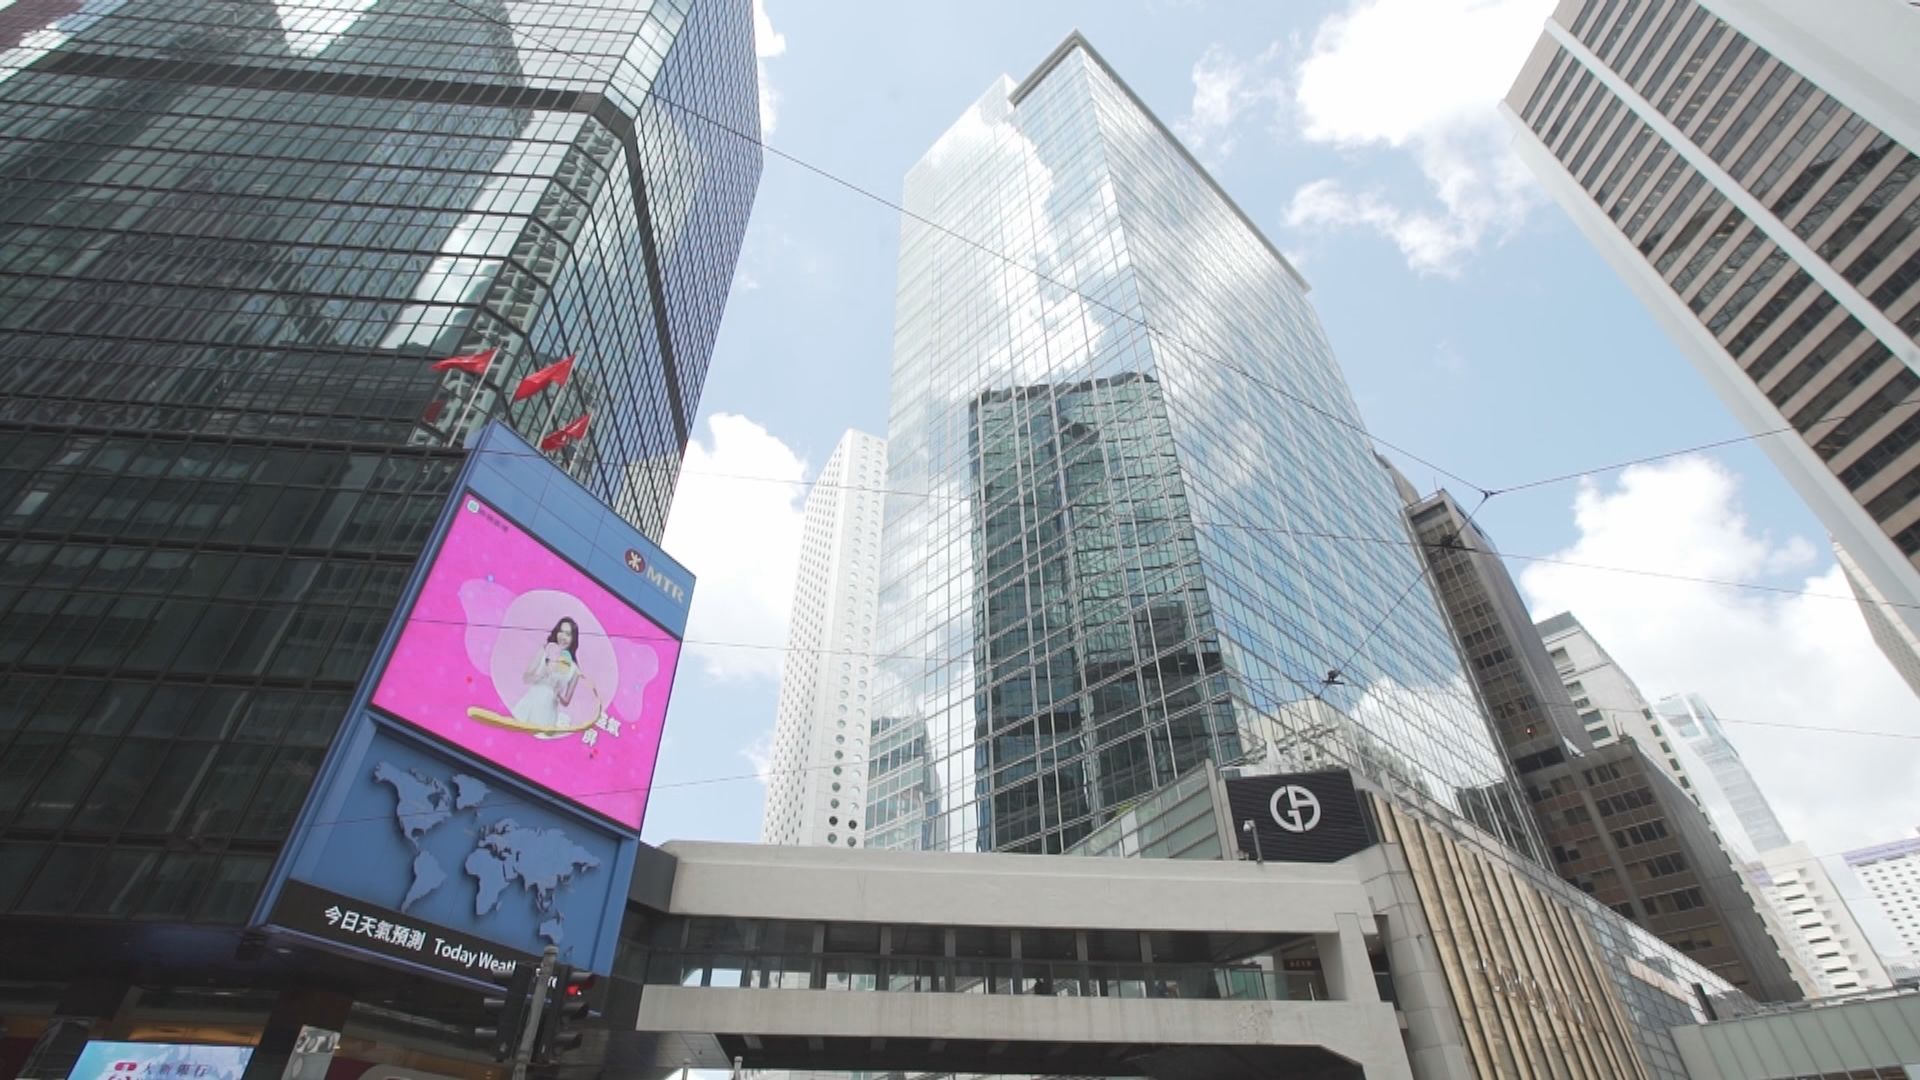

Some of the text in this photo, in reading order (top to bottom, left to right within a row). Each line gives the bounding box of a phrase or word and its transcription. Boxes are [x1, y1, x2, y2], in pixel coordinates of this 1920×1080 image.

[646, 565, 684, 603] MTR
[324, 905, 426, 951] 今日天氣預測
[434, 938, 477, 968] Today
